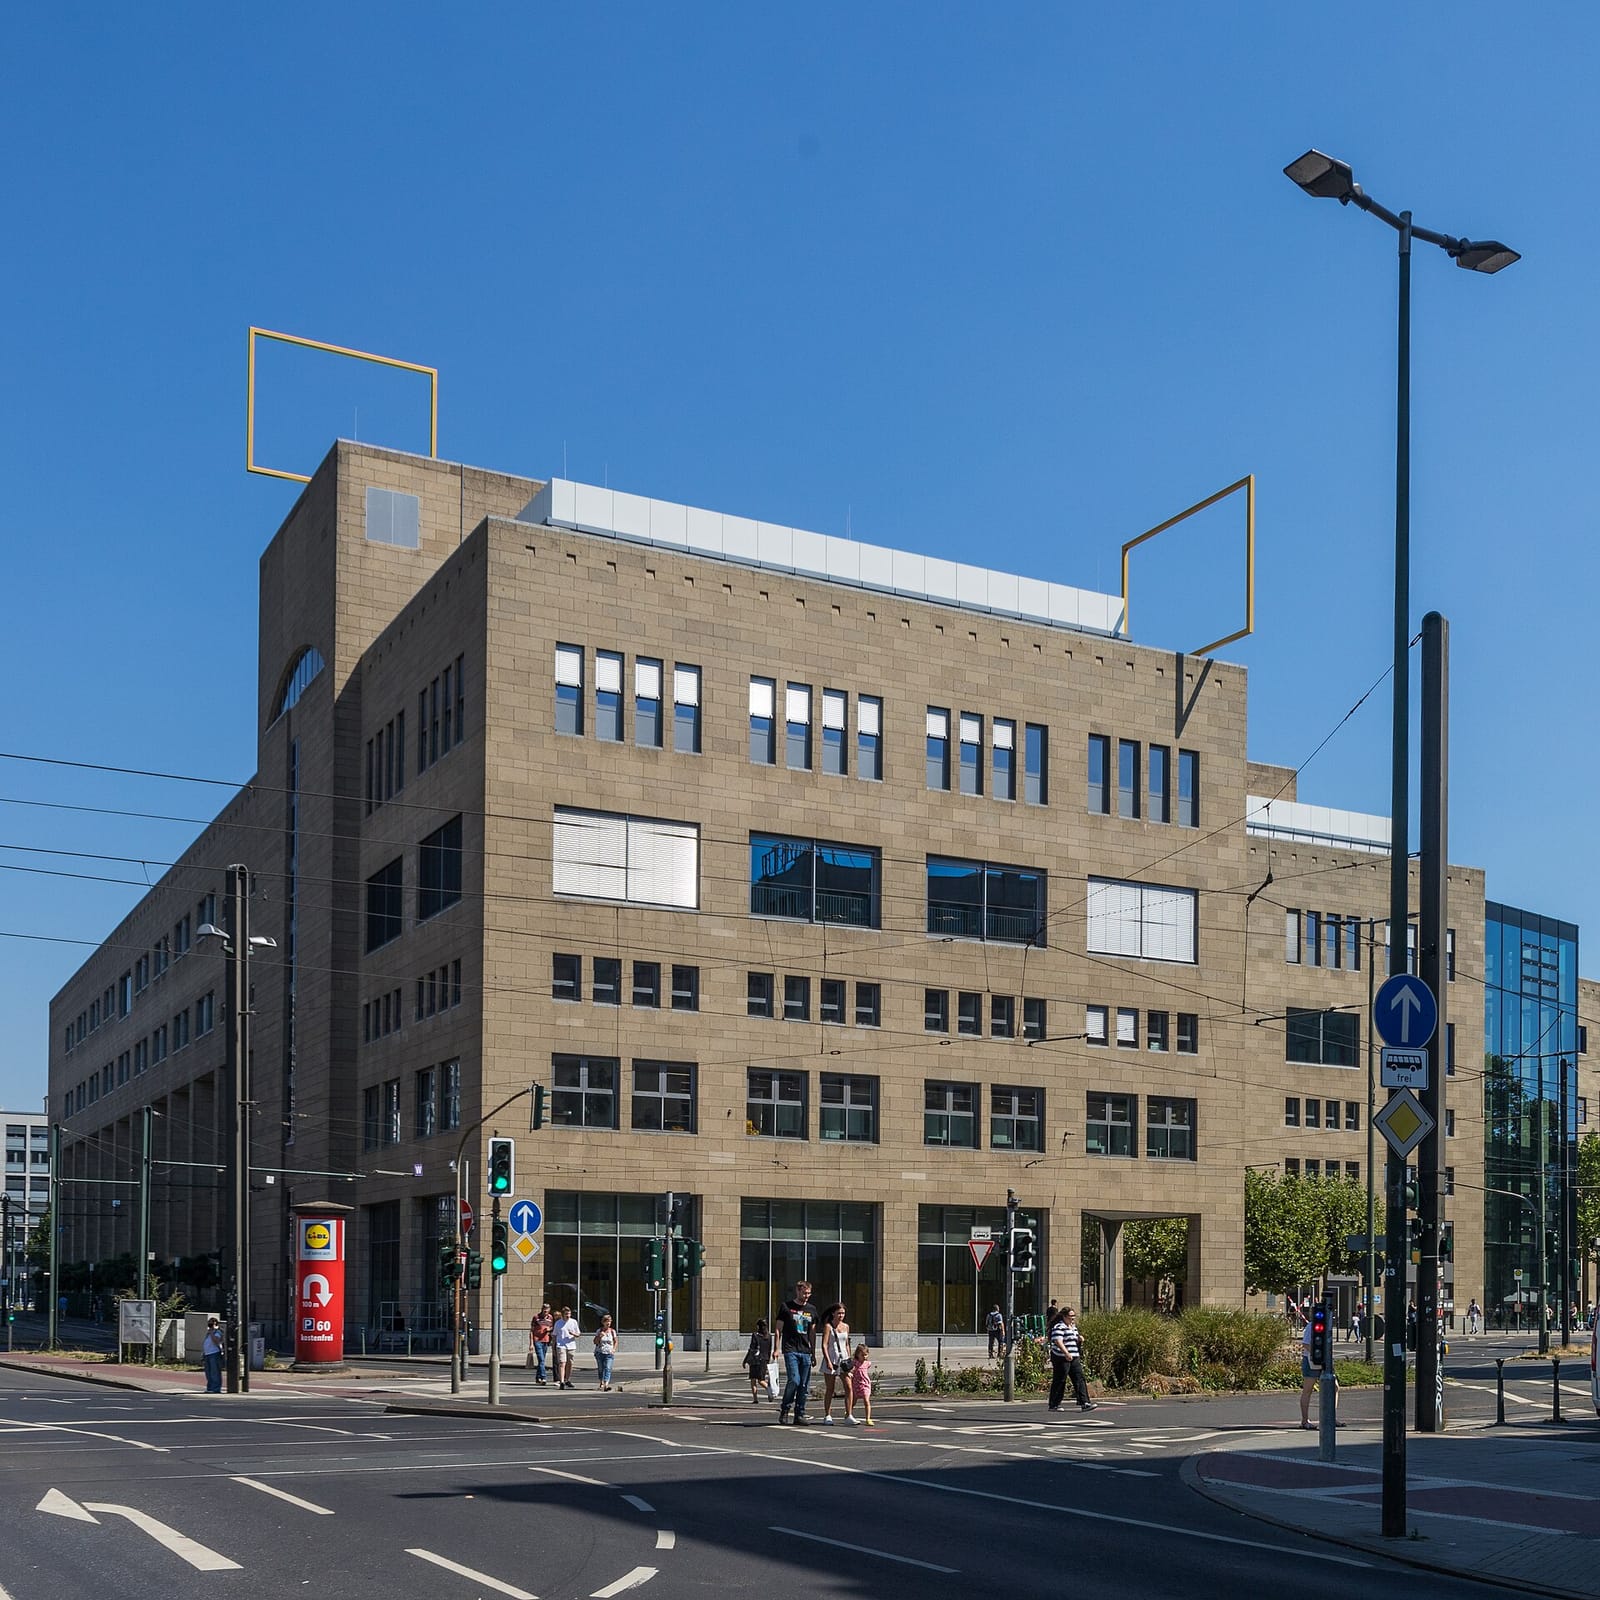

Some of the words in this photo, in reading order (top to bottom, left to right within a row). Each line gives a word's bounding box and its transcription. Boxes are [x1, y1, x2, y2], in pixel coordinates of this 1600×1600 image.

[1397, 1073, 1412, 1083] frei
[316, 1320, 331, 1332] 60
[300, 1333, 334, 1342] kostenfrei
